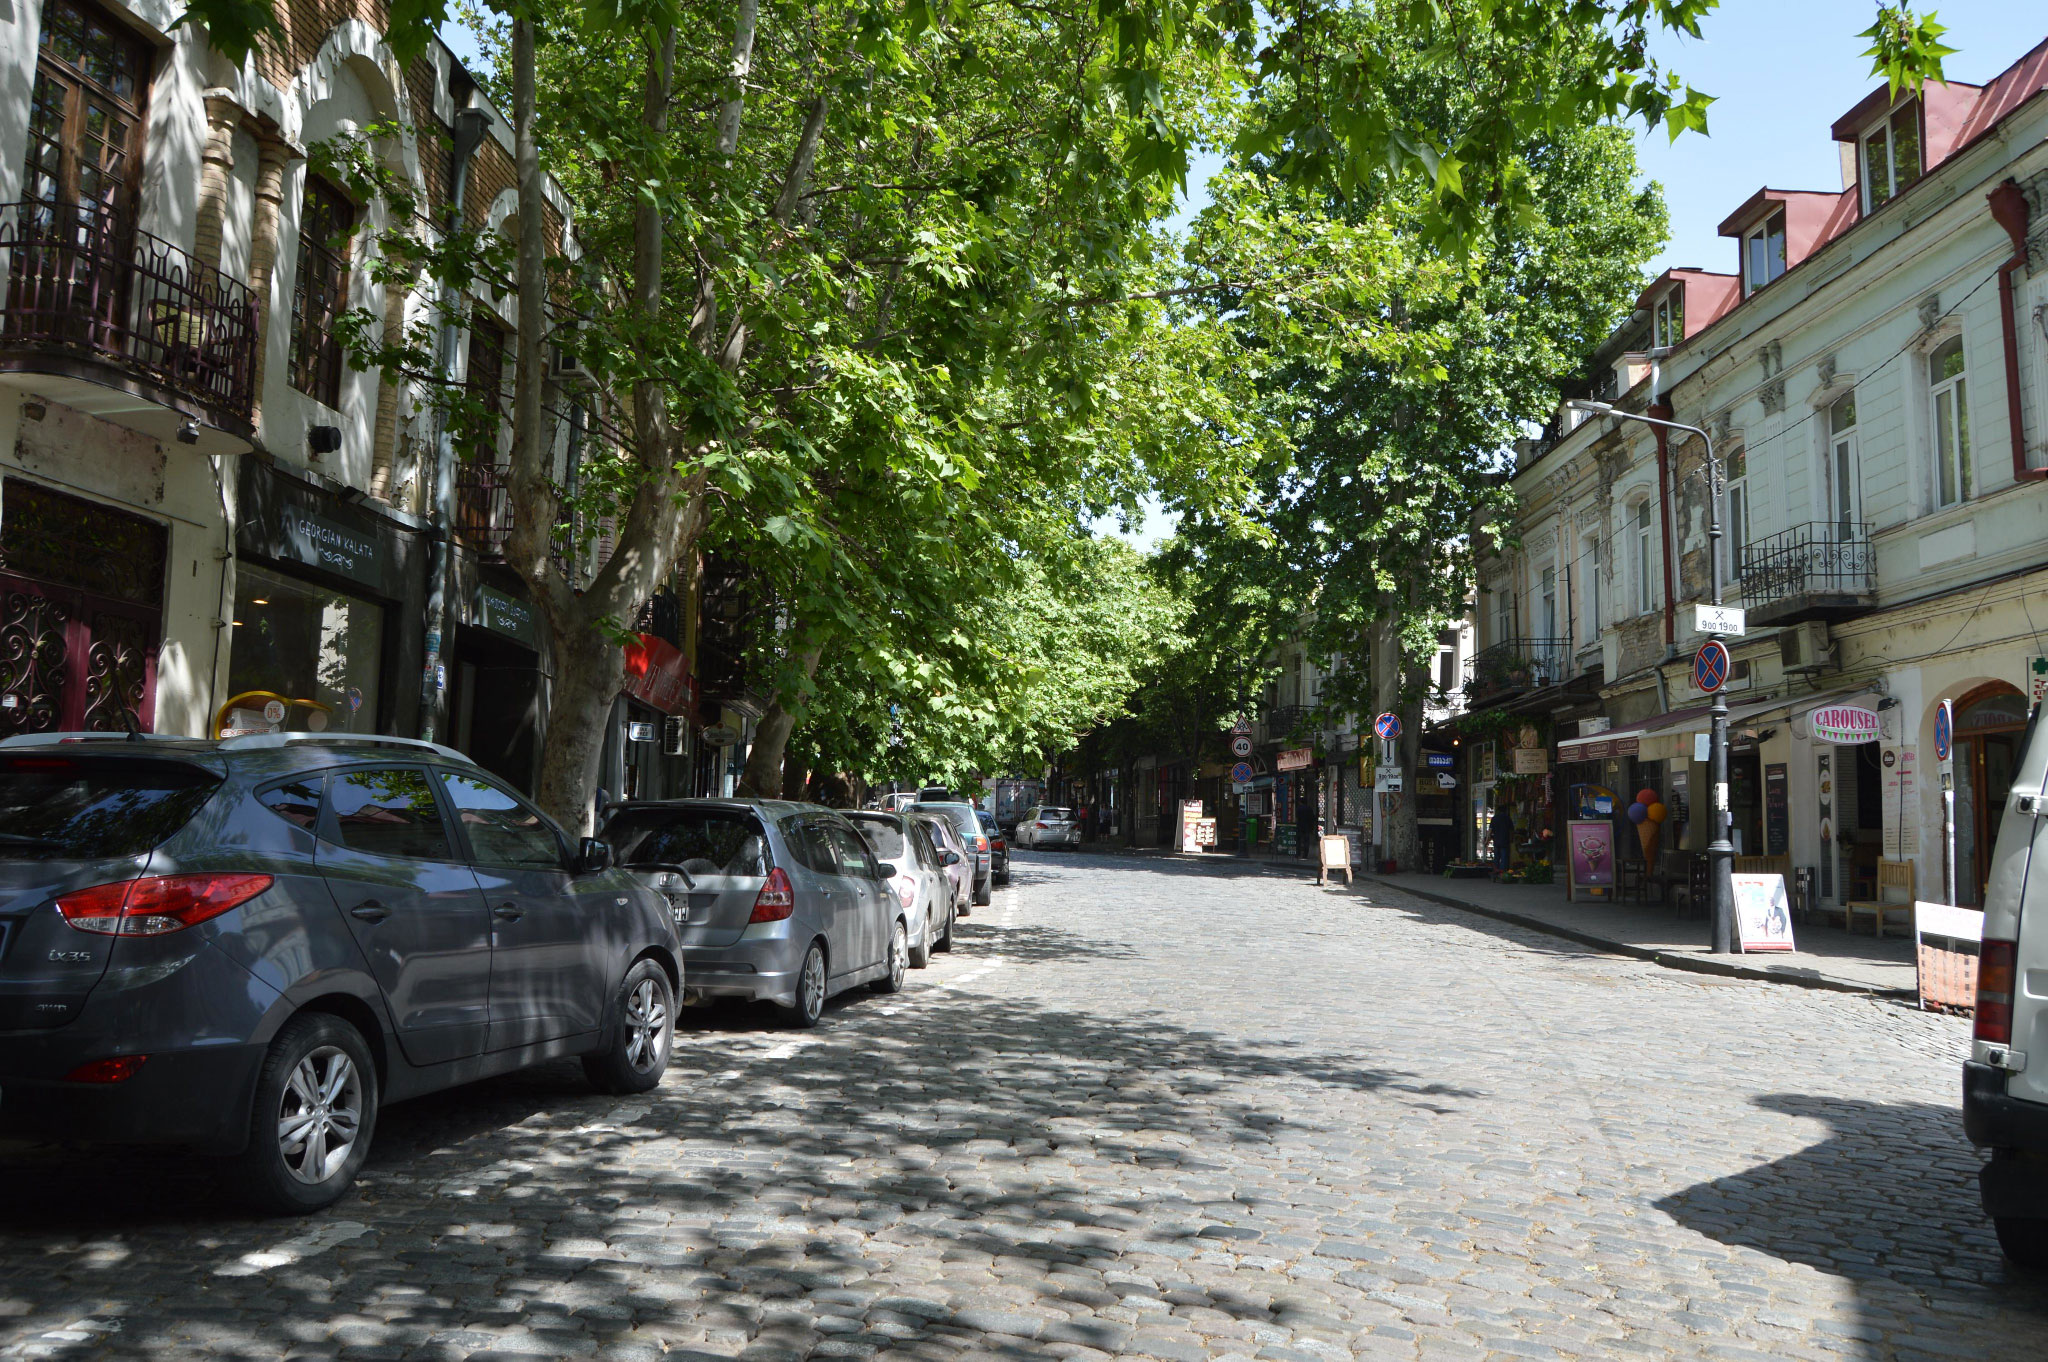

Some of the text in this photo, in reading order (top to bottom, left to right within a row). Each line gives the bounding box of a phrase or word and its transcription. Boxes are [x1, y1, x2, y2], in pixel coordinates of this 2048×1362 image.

[299, 519, 373, 559] GEORGIAN KALATA
[267, 707, 281, 719] 0%
[1815, 709, 1878, 730] CAROUSEL
[1236, 743, 1249, 751] 40
[48, 949, 91, 962] ix35
